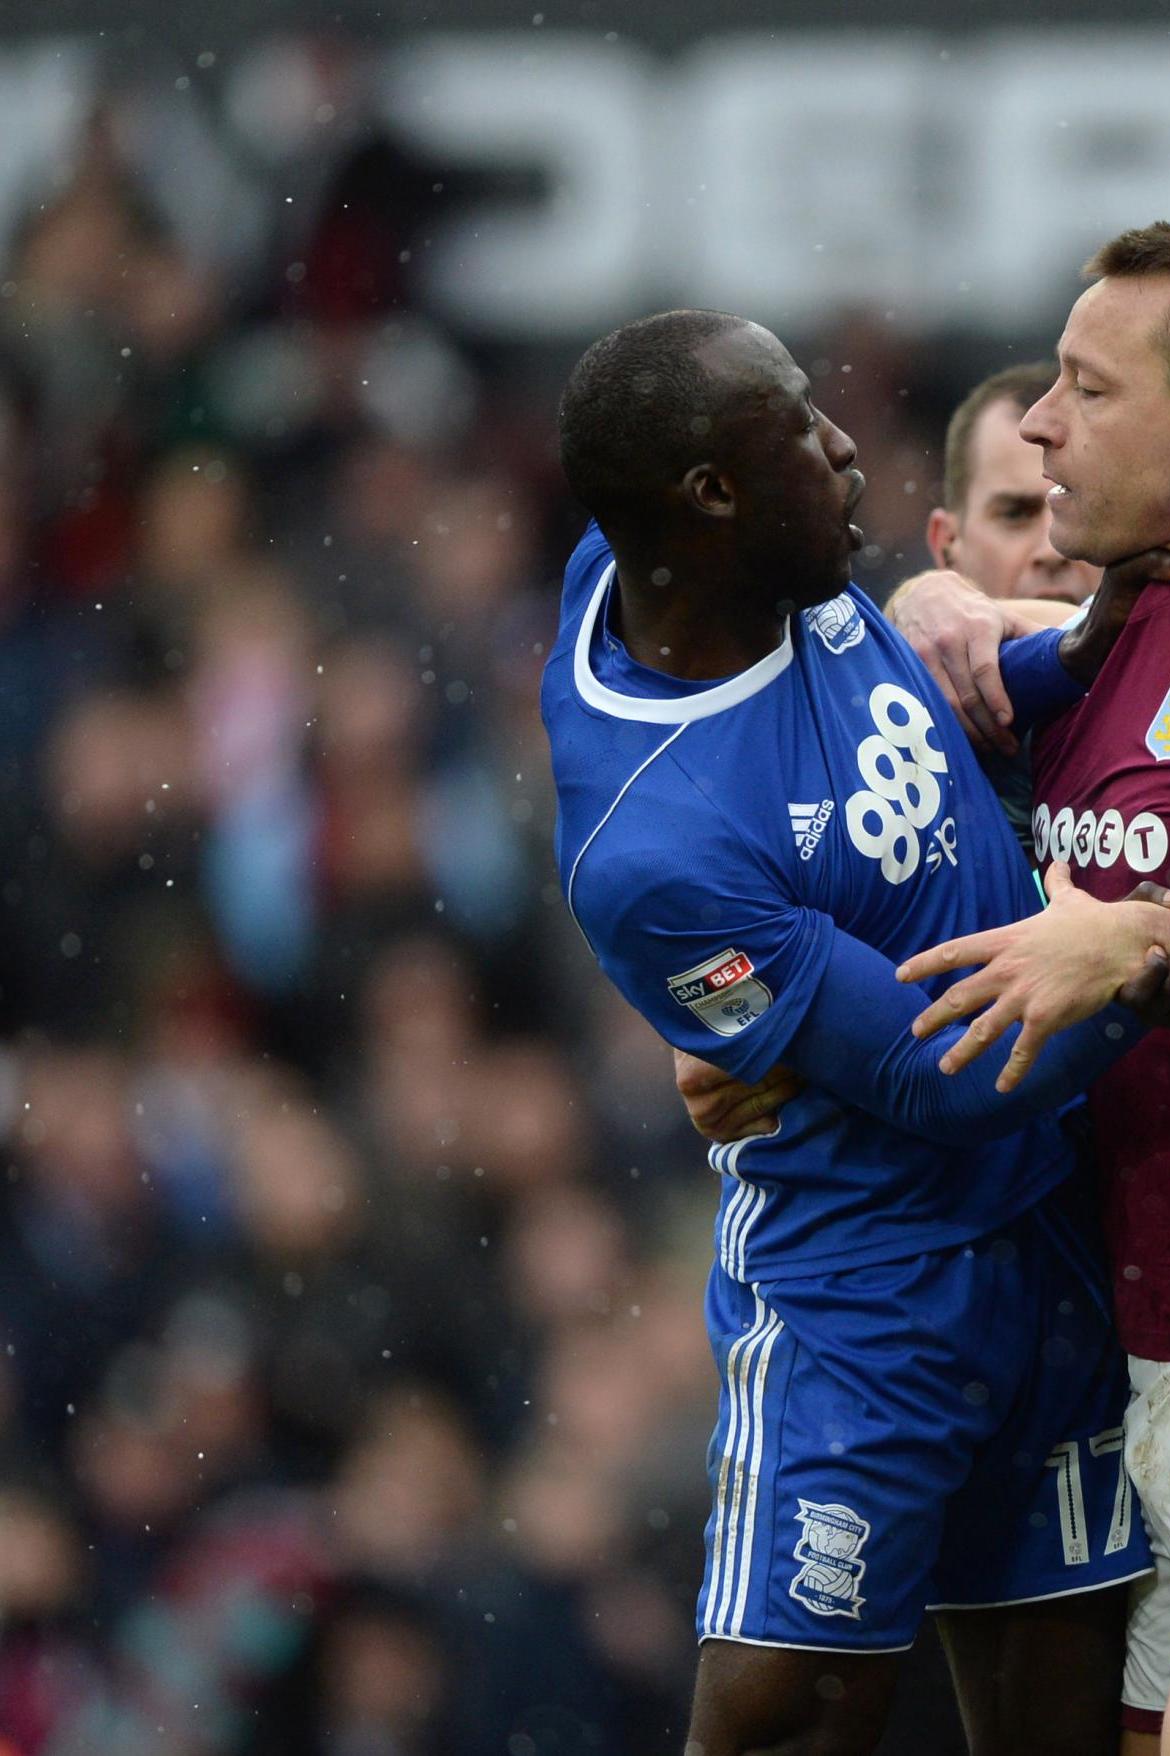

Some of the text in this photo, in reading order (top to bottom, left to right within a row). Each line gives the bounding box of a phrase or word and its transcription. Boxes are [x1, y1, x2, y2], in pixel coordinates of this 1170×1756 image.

[800, 798, 834, 862] adidas
[675, 958, 744, 1001] sky BET
[736, 1010, 761, 1027] EFL
[1043, 1426, 1133, 1566] 17
[848, 1524, 863, 1535] CITY
